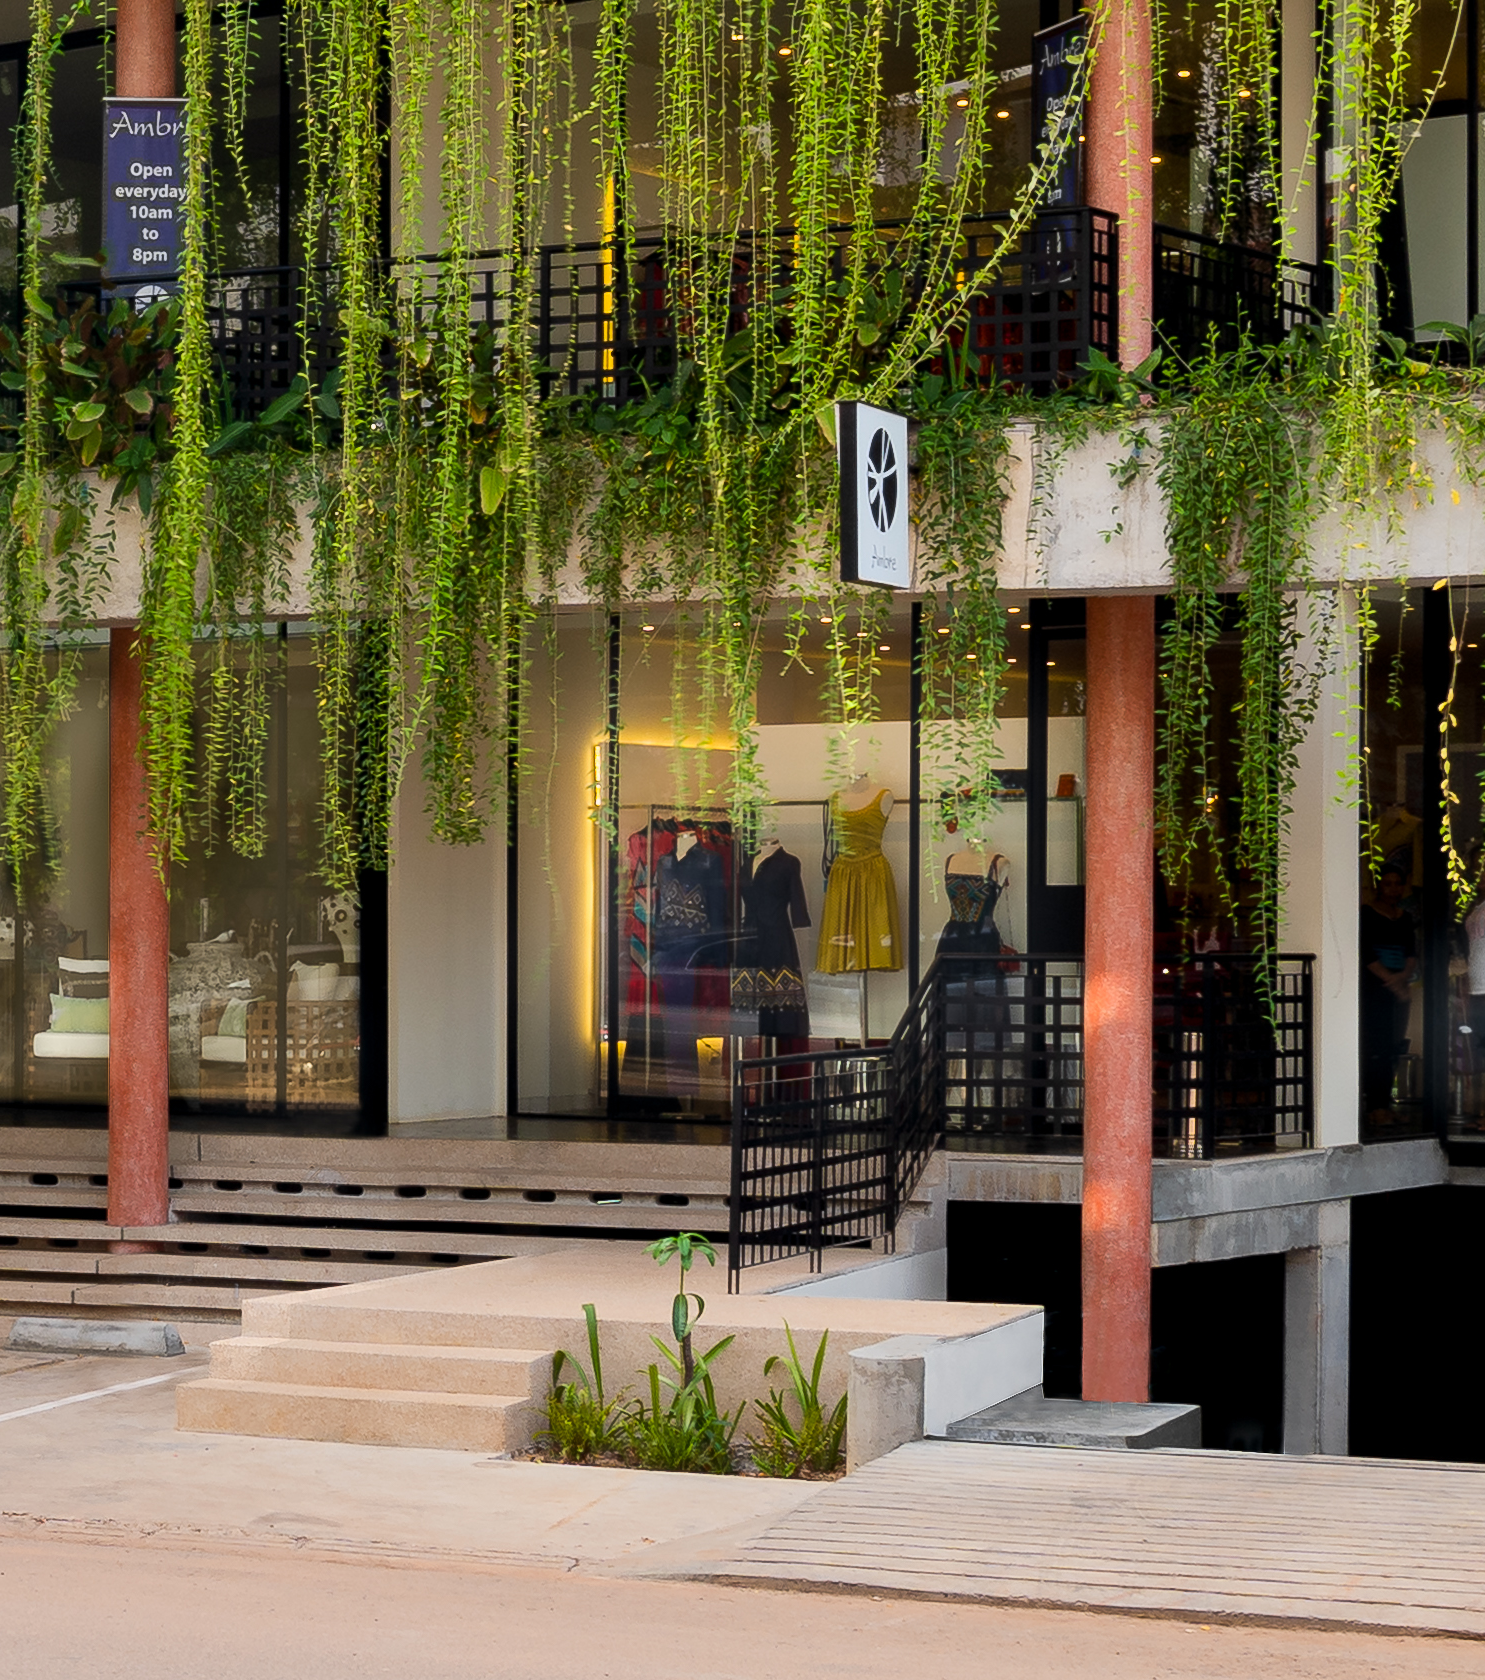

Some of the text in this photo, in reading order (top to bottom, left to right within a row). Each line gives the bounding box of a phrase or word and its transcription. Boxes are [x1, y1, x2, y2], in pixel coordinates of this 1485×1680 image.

[109, 110, 185, 138] Ambr
[130, 162, 173, 179] Open
[115, 183, 188, 201] everyday
[130, 206, 173, 220] 10am
[142, 228, 159, 241] to
[132, 248, 168, 264] 8pm
[871, 544, 897, 571] Ambre
